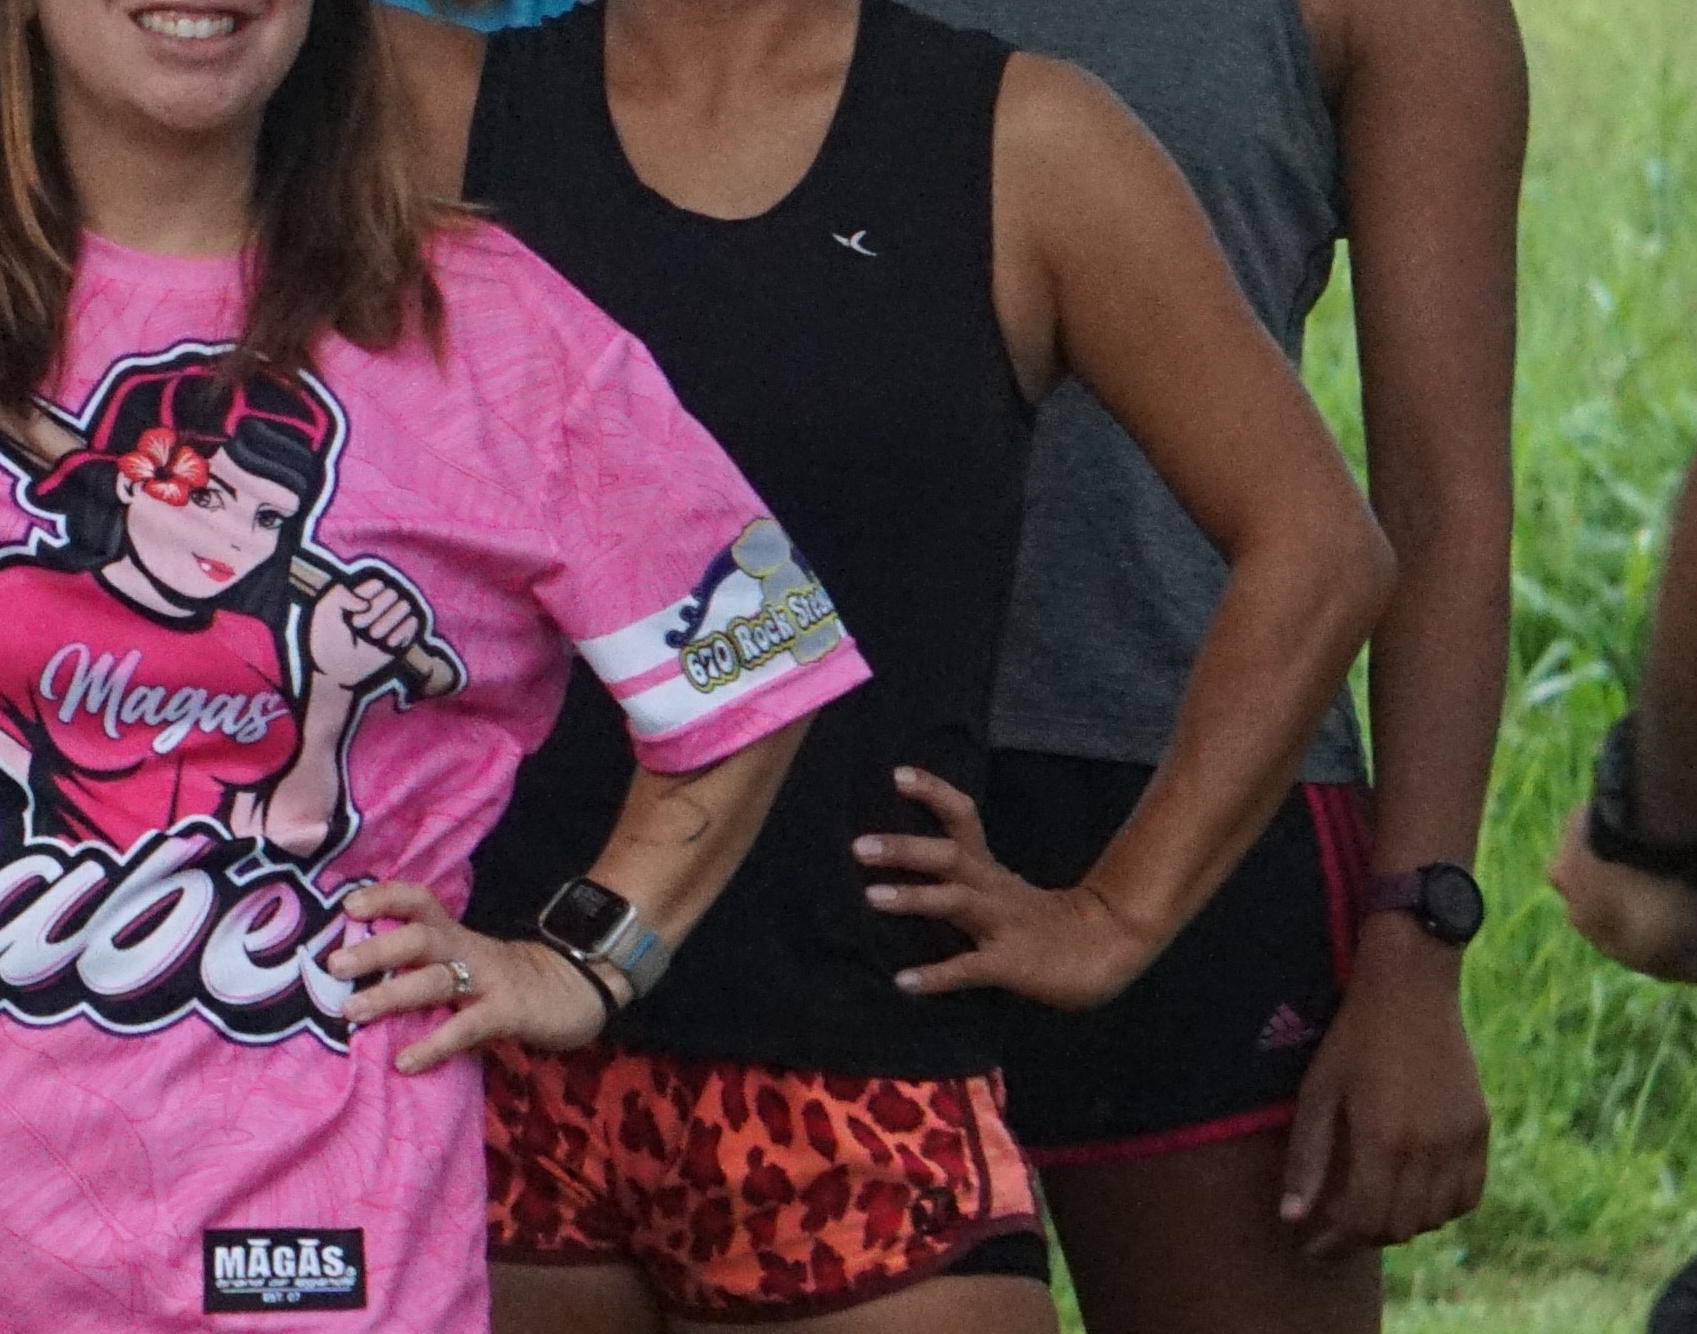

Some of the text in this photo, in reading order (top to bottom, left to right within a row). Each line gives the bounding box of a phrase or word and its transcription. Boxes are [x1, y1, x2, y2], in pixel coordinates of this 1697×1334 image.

[685, 637, 736, 687] 670
[733, 605, 796, 663] Rock
[39, 641, 290, 755] Magas
